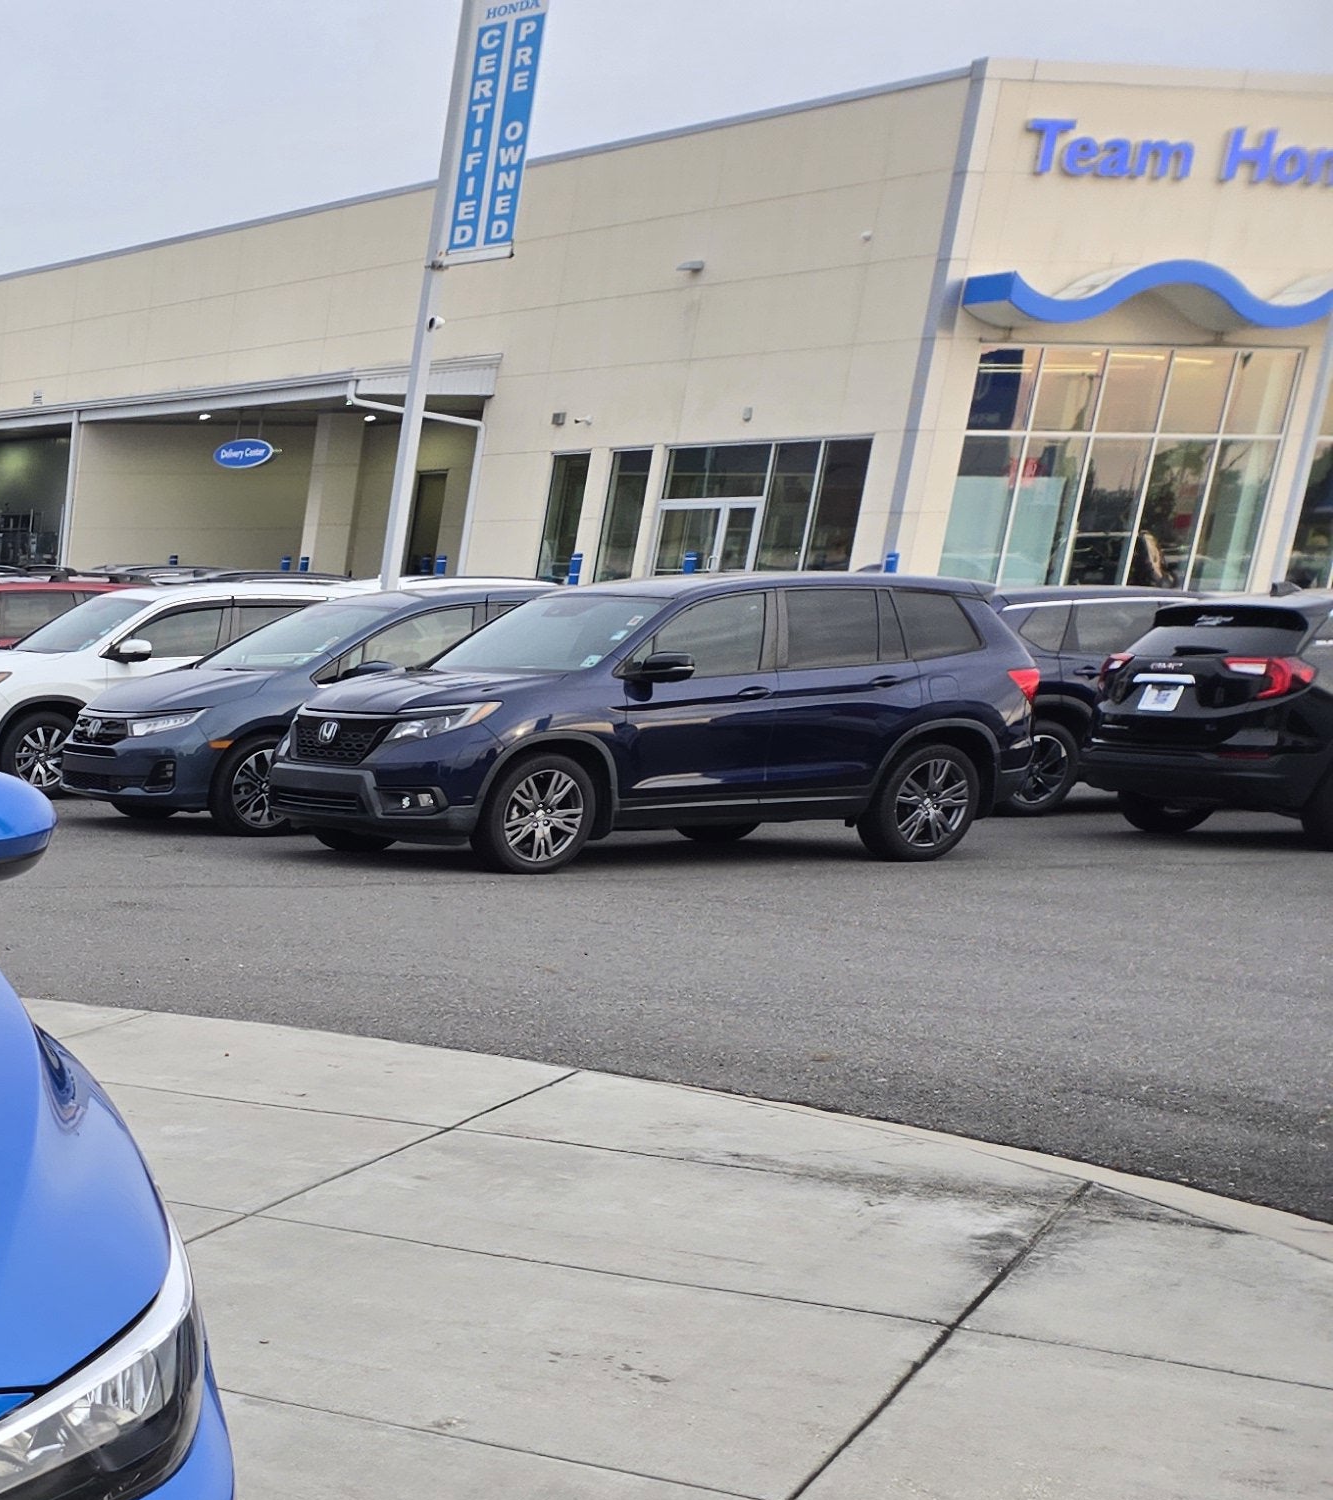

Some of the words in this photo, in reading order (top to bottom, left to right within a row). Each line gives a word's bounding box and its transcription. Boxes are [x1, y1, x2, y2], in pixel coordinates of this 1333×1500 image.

[485, 0, 541, 20] HONDA
[512, 20, 537, 93] PRE
[452, 29, 501, 246] CERTIFIED
[1027, 117, 1195, 180] Team
[490, 120, 524, 241] OWNED
[220, 448, 245, 460] Delivery
[244, 447, 267, 458] Center
